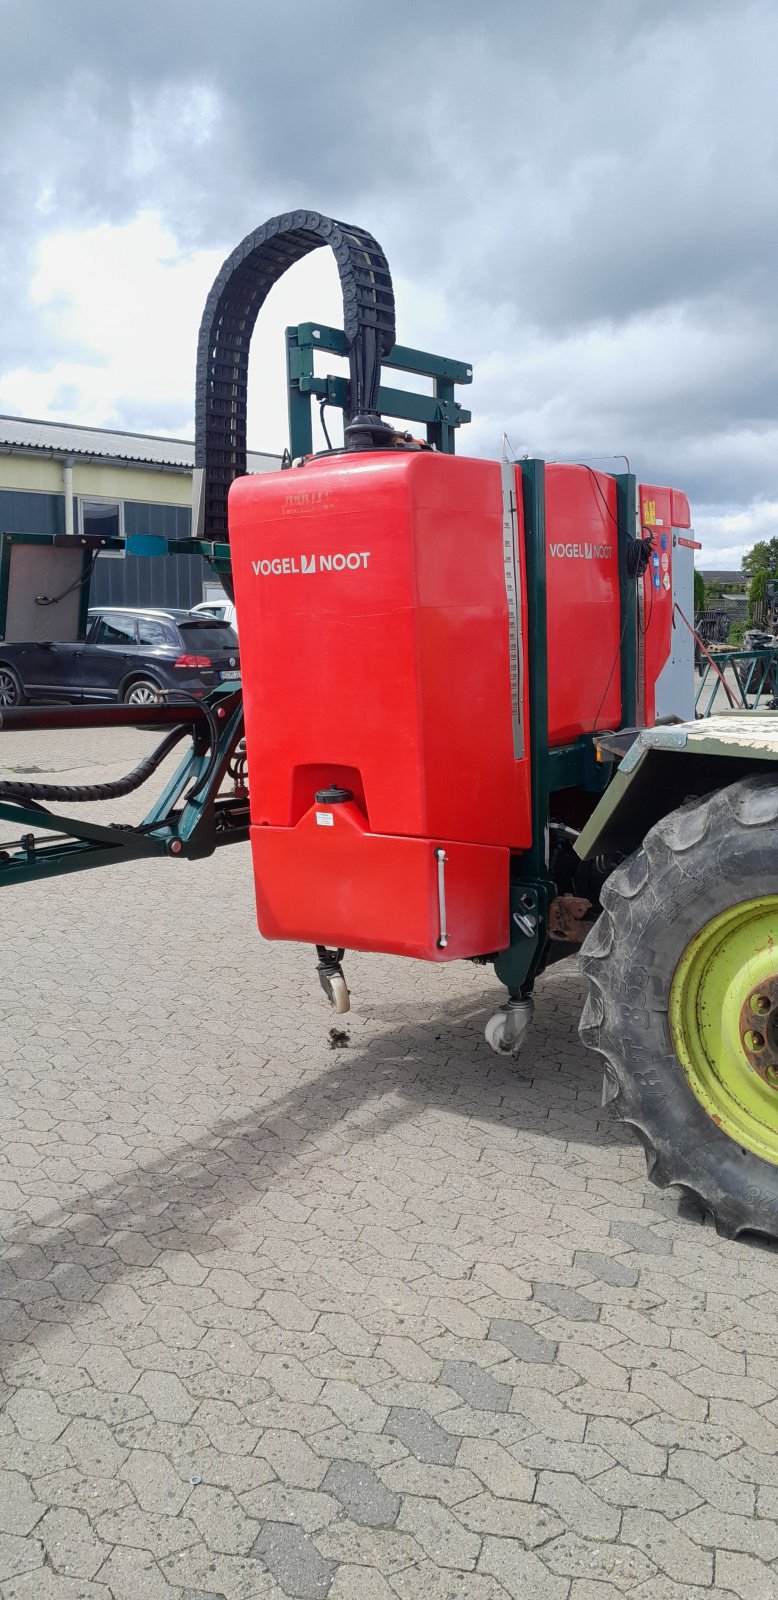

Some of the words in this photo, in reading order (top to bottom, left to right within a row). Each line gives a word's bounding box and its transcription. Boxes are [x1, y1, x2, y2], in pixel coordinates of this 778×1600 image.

[549, 543, 585, 558] VOGEL
[594, 545, 613, 559] NOOT
[251, 557, 300, 576] VOGEL
[319, 552, 371, 572] NOOT
